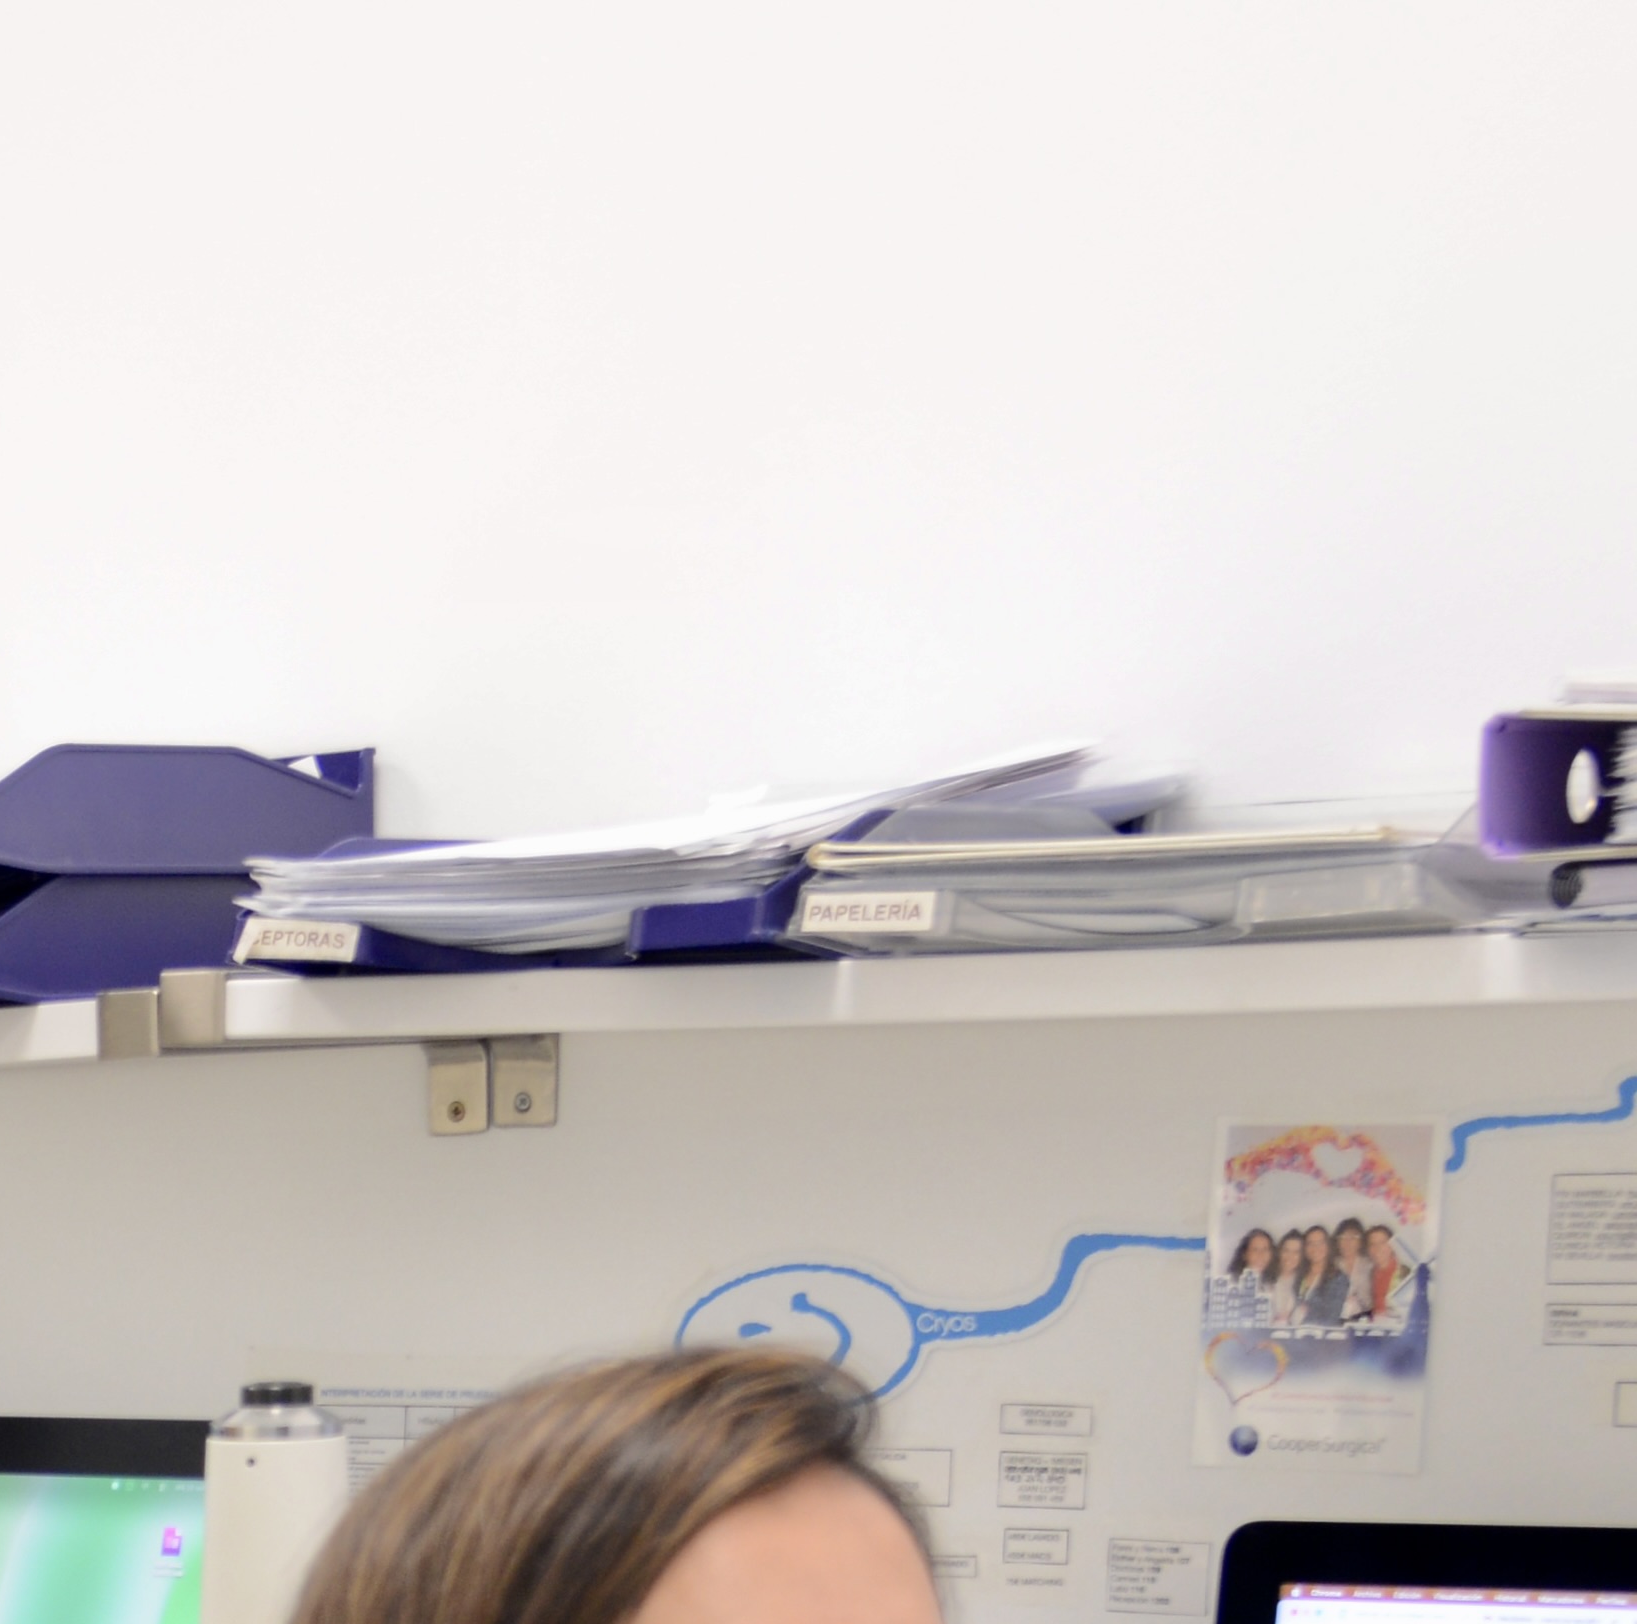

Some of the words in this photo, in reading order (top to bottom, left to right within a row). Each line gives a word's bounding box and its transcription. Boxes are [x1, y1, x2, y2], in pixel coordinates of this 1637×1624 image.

[809, 900, 920, 921] PAPELERÍA
[916, 1313, 977, 1337] Cryos
[1311, 1589, 1342, 1598] Chrome
